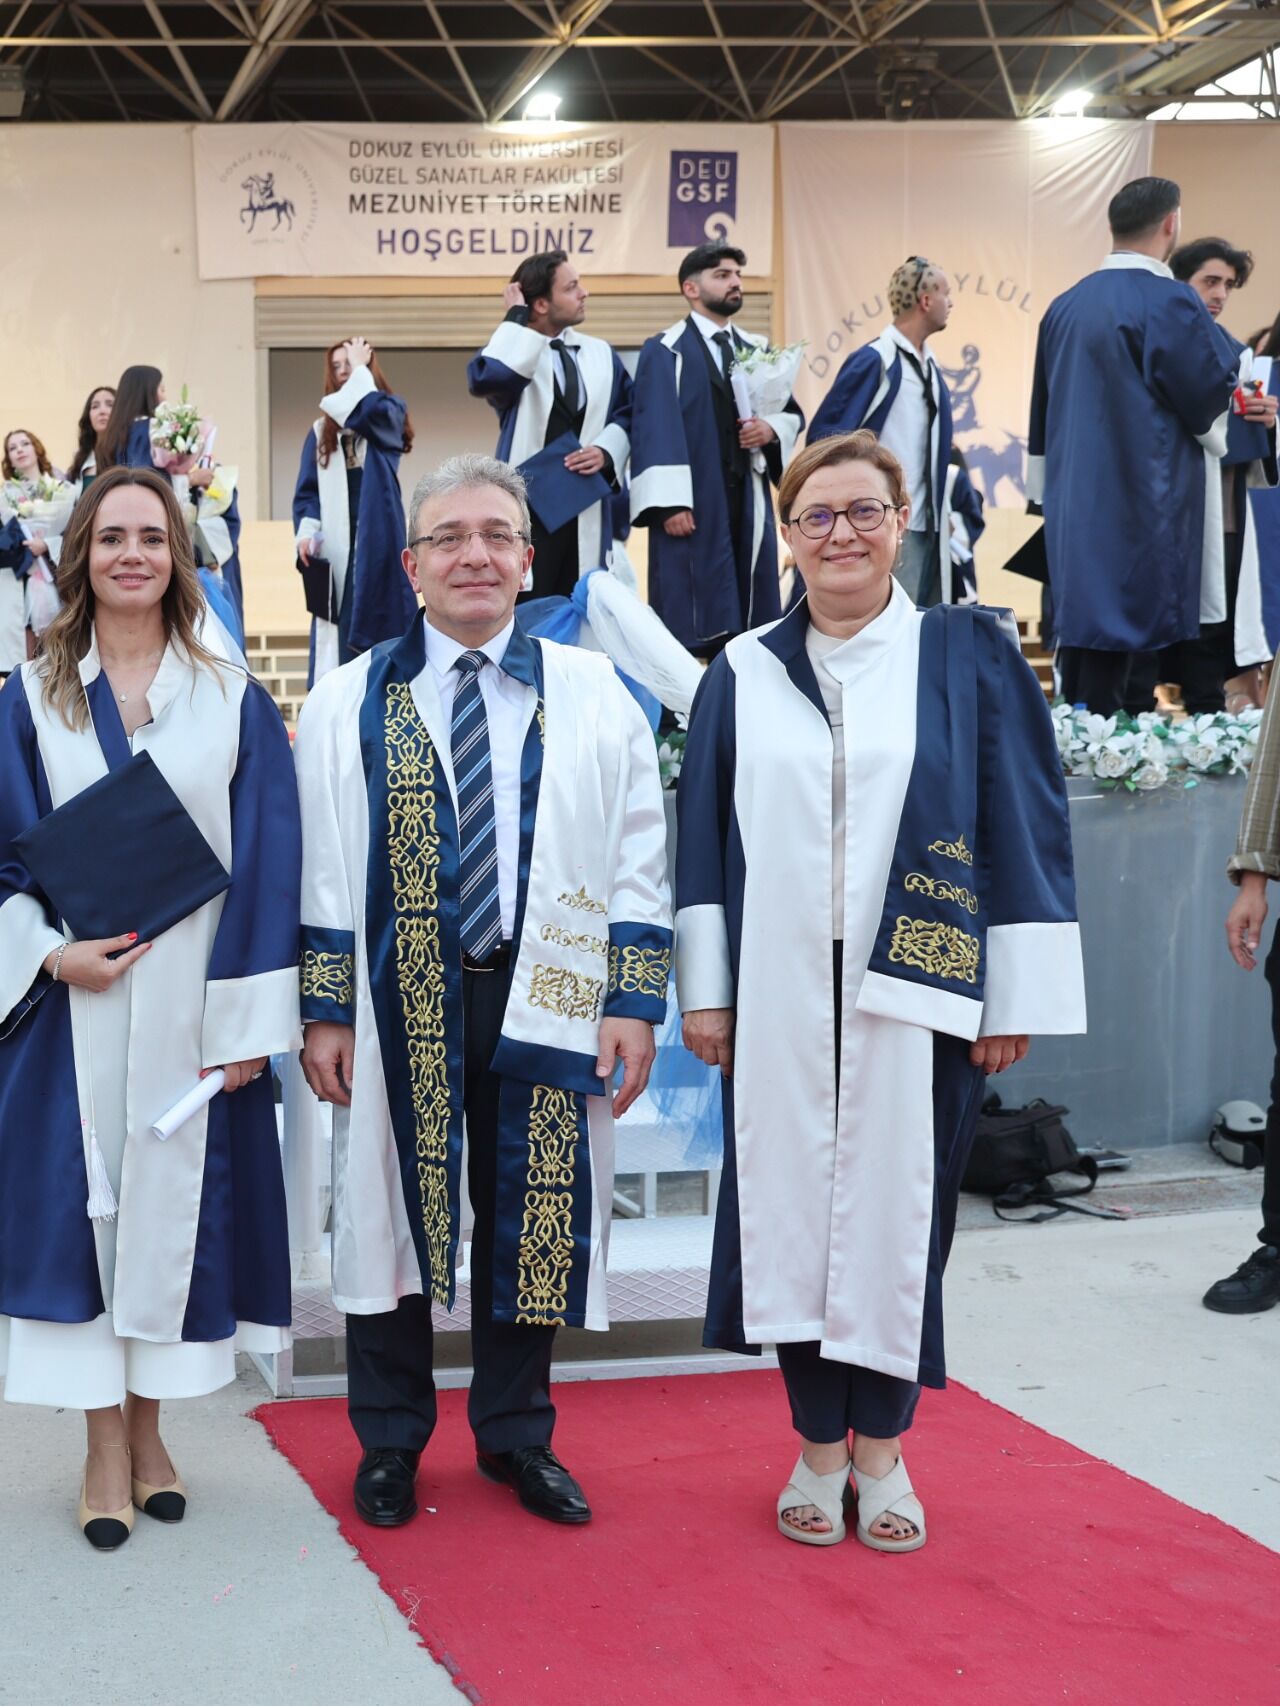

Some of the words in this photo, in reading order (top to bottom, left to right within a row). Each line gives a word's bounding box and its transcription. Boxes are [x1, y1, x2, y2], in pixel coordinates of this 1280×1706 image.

[349, 140, 413, 159] DOKUZ
[421, 139, 481, 159] EYLÜL
[489, 138, 625, 159] ÜNİVERSİTESİ
[349, 163, 409, 185] GÜZEL
[416, 166, 517, 185] SANATLAR
[523, 163, 625, 185] FAKÜLTESİ
[348, 189, 489, 214] MEZUNİYET
[497, 189, 623, 214] TÖRENİNE
[676, 181, 730, 203] GSF
[377, 222, 595, 262] HOŞGELDİNİZ
[809, 295, 884, 379] DOKU
[953, 272, 1033, 314] YLÜL
